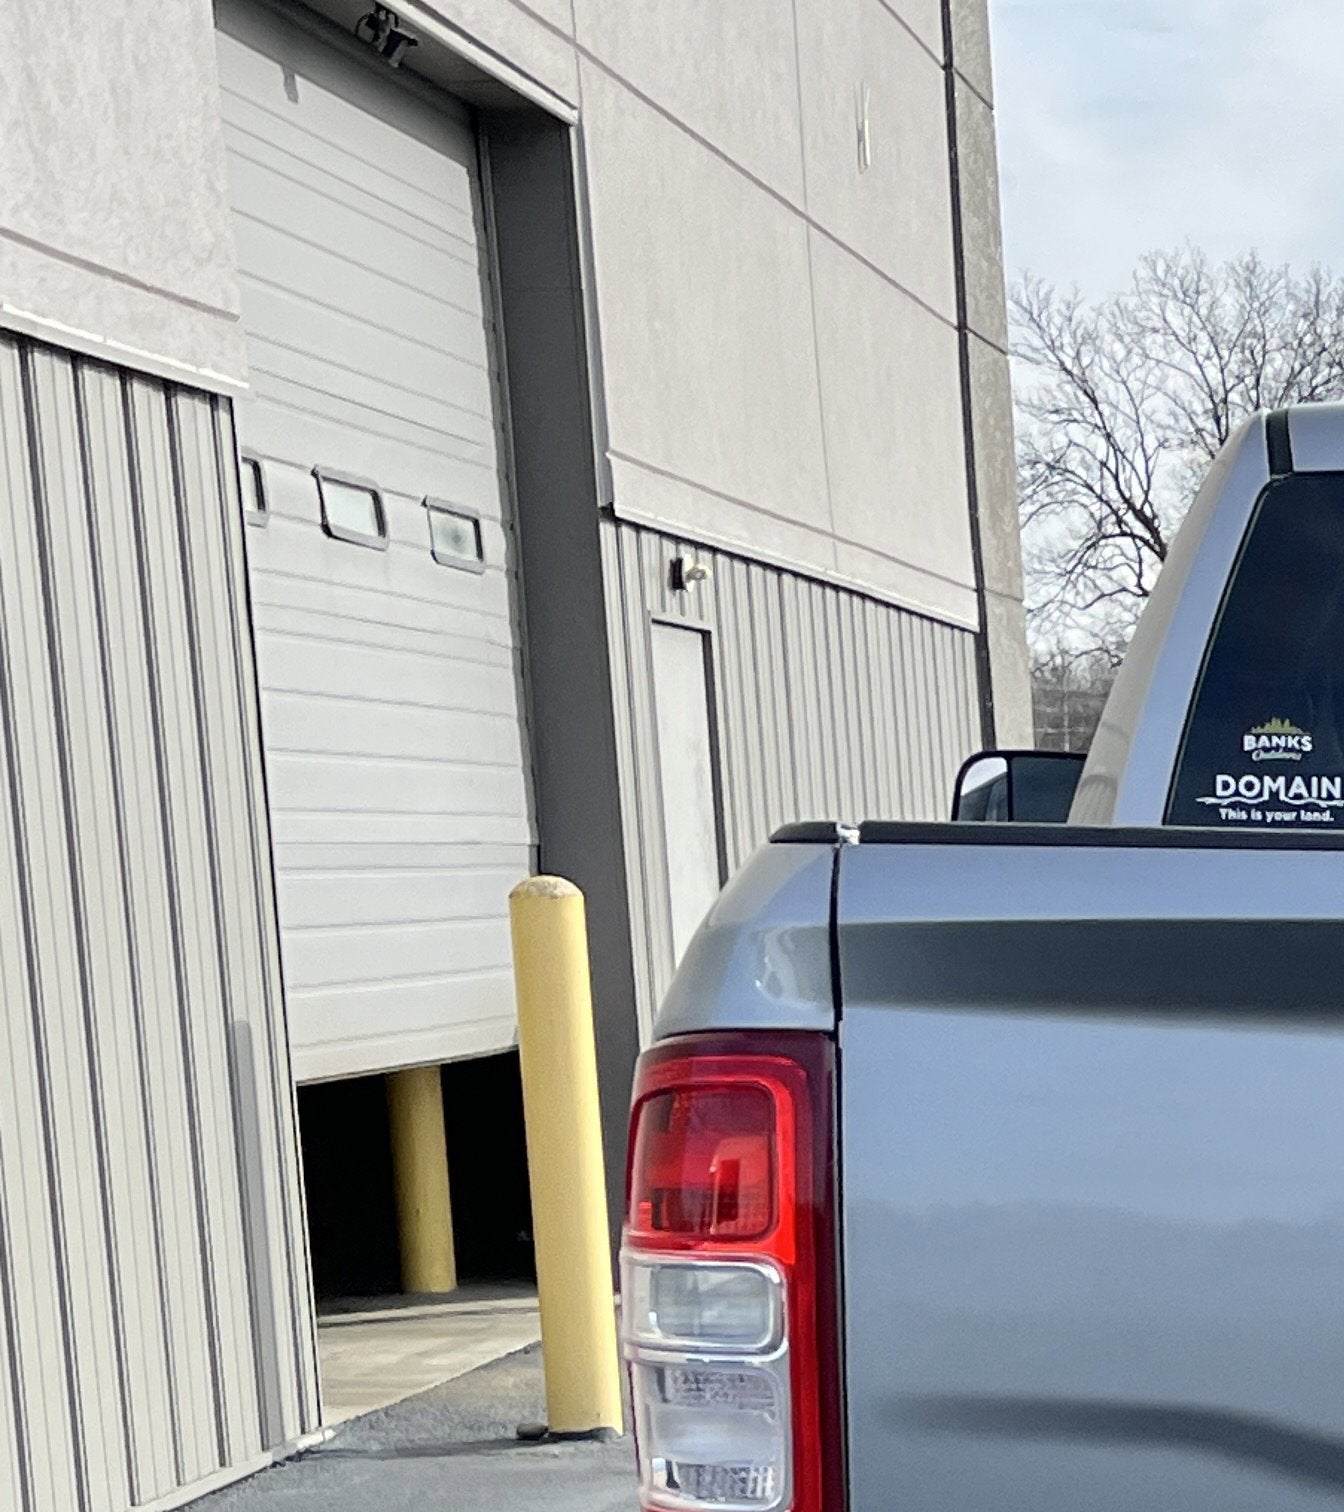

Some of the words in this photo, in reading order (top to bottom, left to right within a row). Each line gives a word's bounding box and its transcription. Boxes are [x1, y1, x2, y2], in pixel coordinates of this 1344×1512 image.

[1243, 734, 1313, 751] BANKS
[1215, 774, 1341, 801] DOMAIN
[1219, 808, 1248, 820] This
[1250, 808, 1262, 820] is
[1265, 811, 1297, 823] your
[1300, 809, 1335, 821] land.
